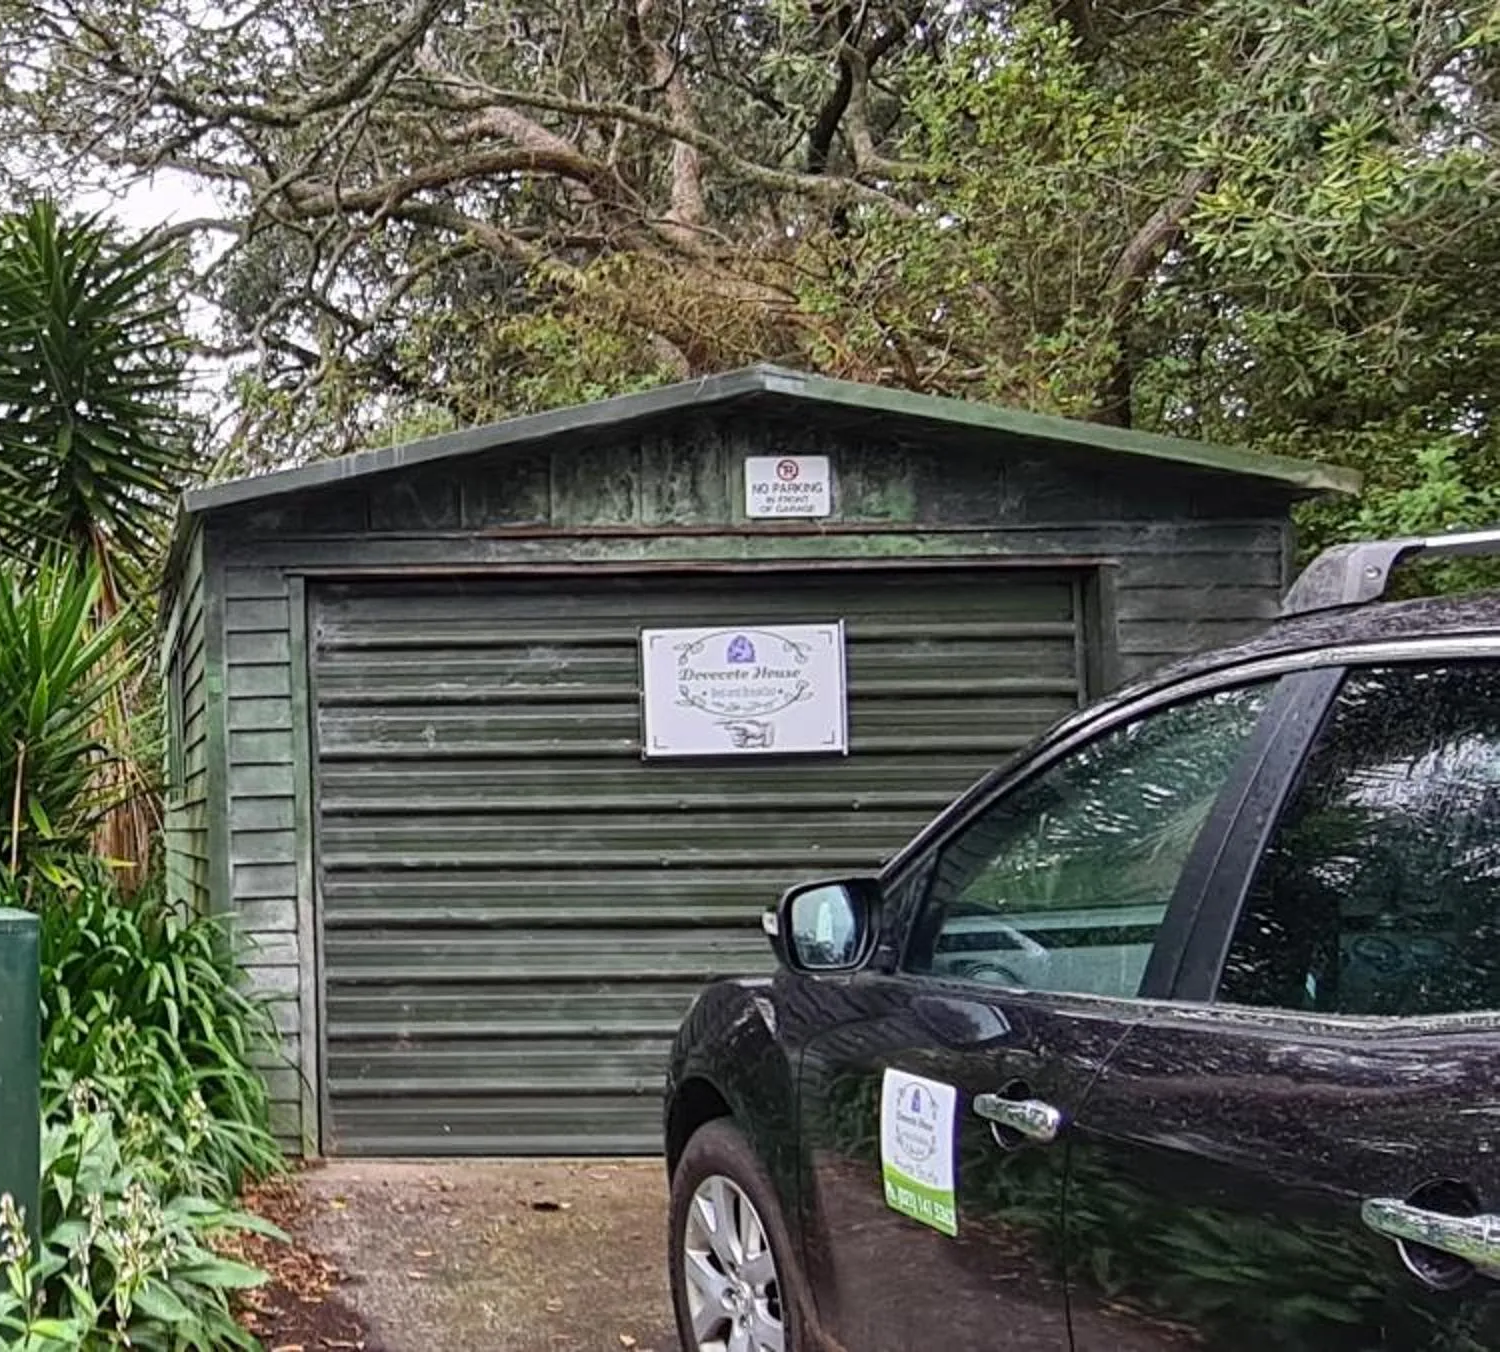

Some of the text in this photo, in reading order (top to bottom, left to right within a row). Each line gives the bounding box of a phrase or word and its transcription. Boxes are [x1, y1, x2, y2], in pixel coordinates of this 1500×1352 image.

[752, 481, 823, 495] NO PARKING
[751, 665, 801, 680] House
